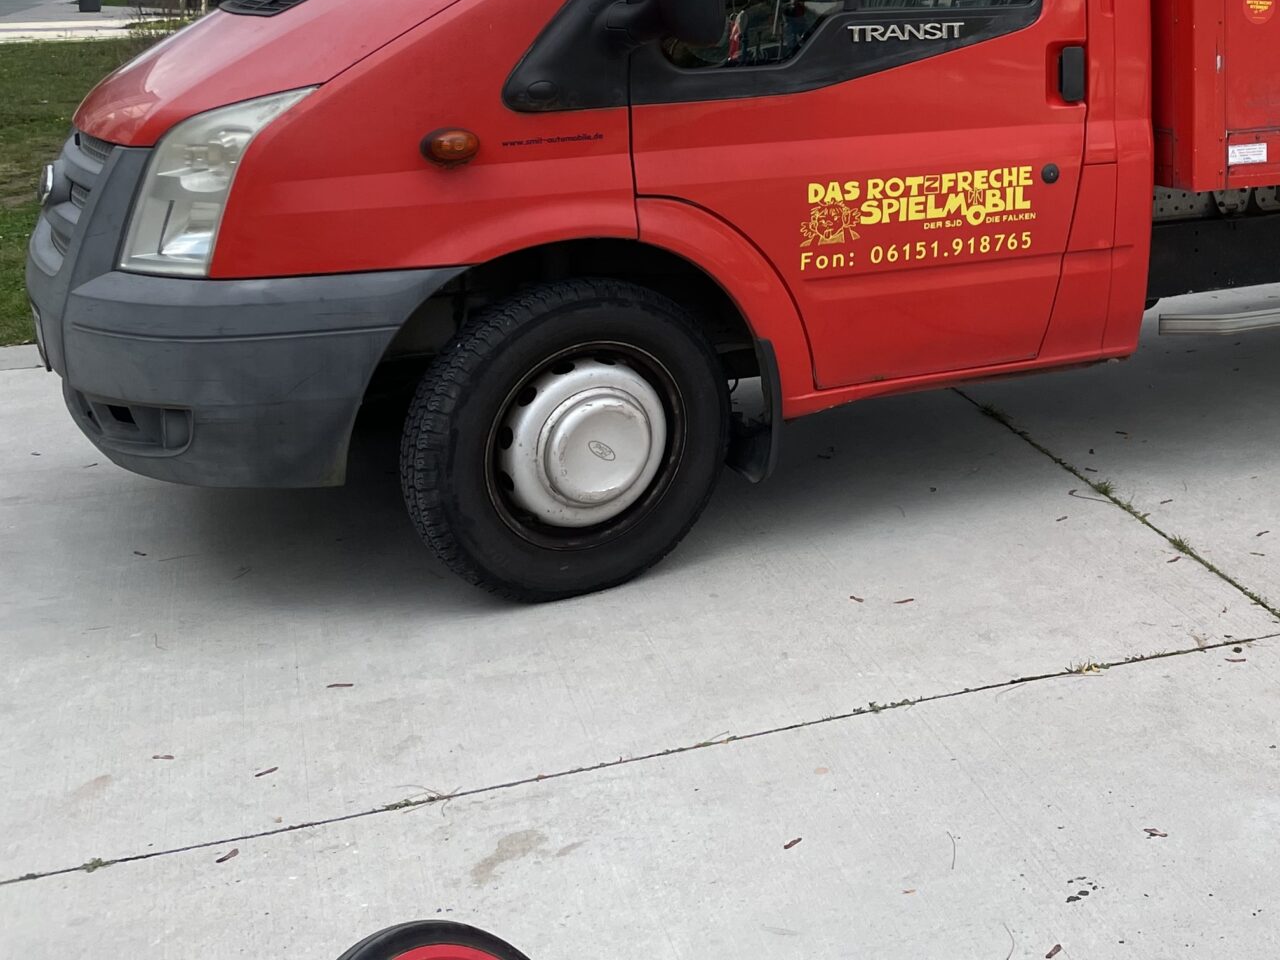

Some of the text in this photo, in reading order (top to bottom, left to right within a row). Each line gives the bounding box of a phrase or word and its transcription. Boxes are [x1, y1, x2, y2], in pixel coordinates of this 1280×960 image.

[847, 22, 965, 42] TRANSIT
[808, 181, 860, 203] DAS
[860, 187, 1031, 226] SPIELMOBIL
[924, 212, 1036, 230] DER SJD DIE FALKEN
[800, 232, 1032, 271] Fon: 06151.918765
